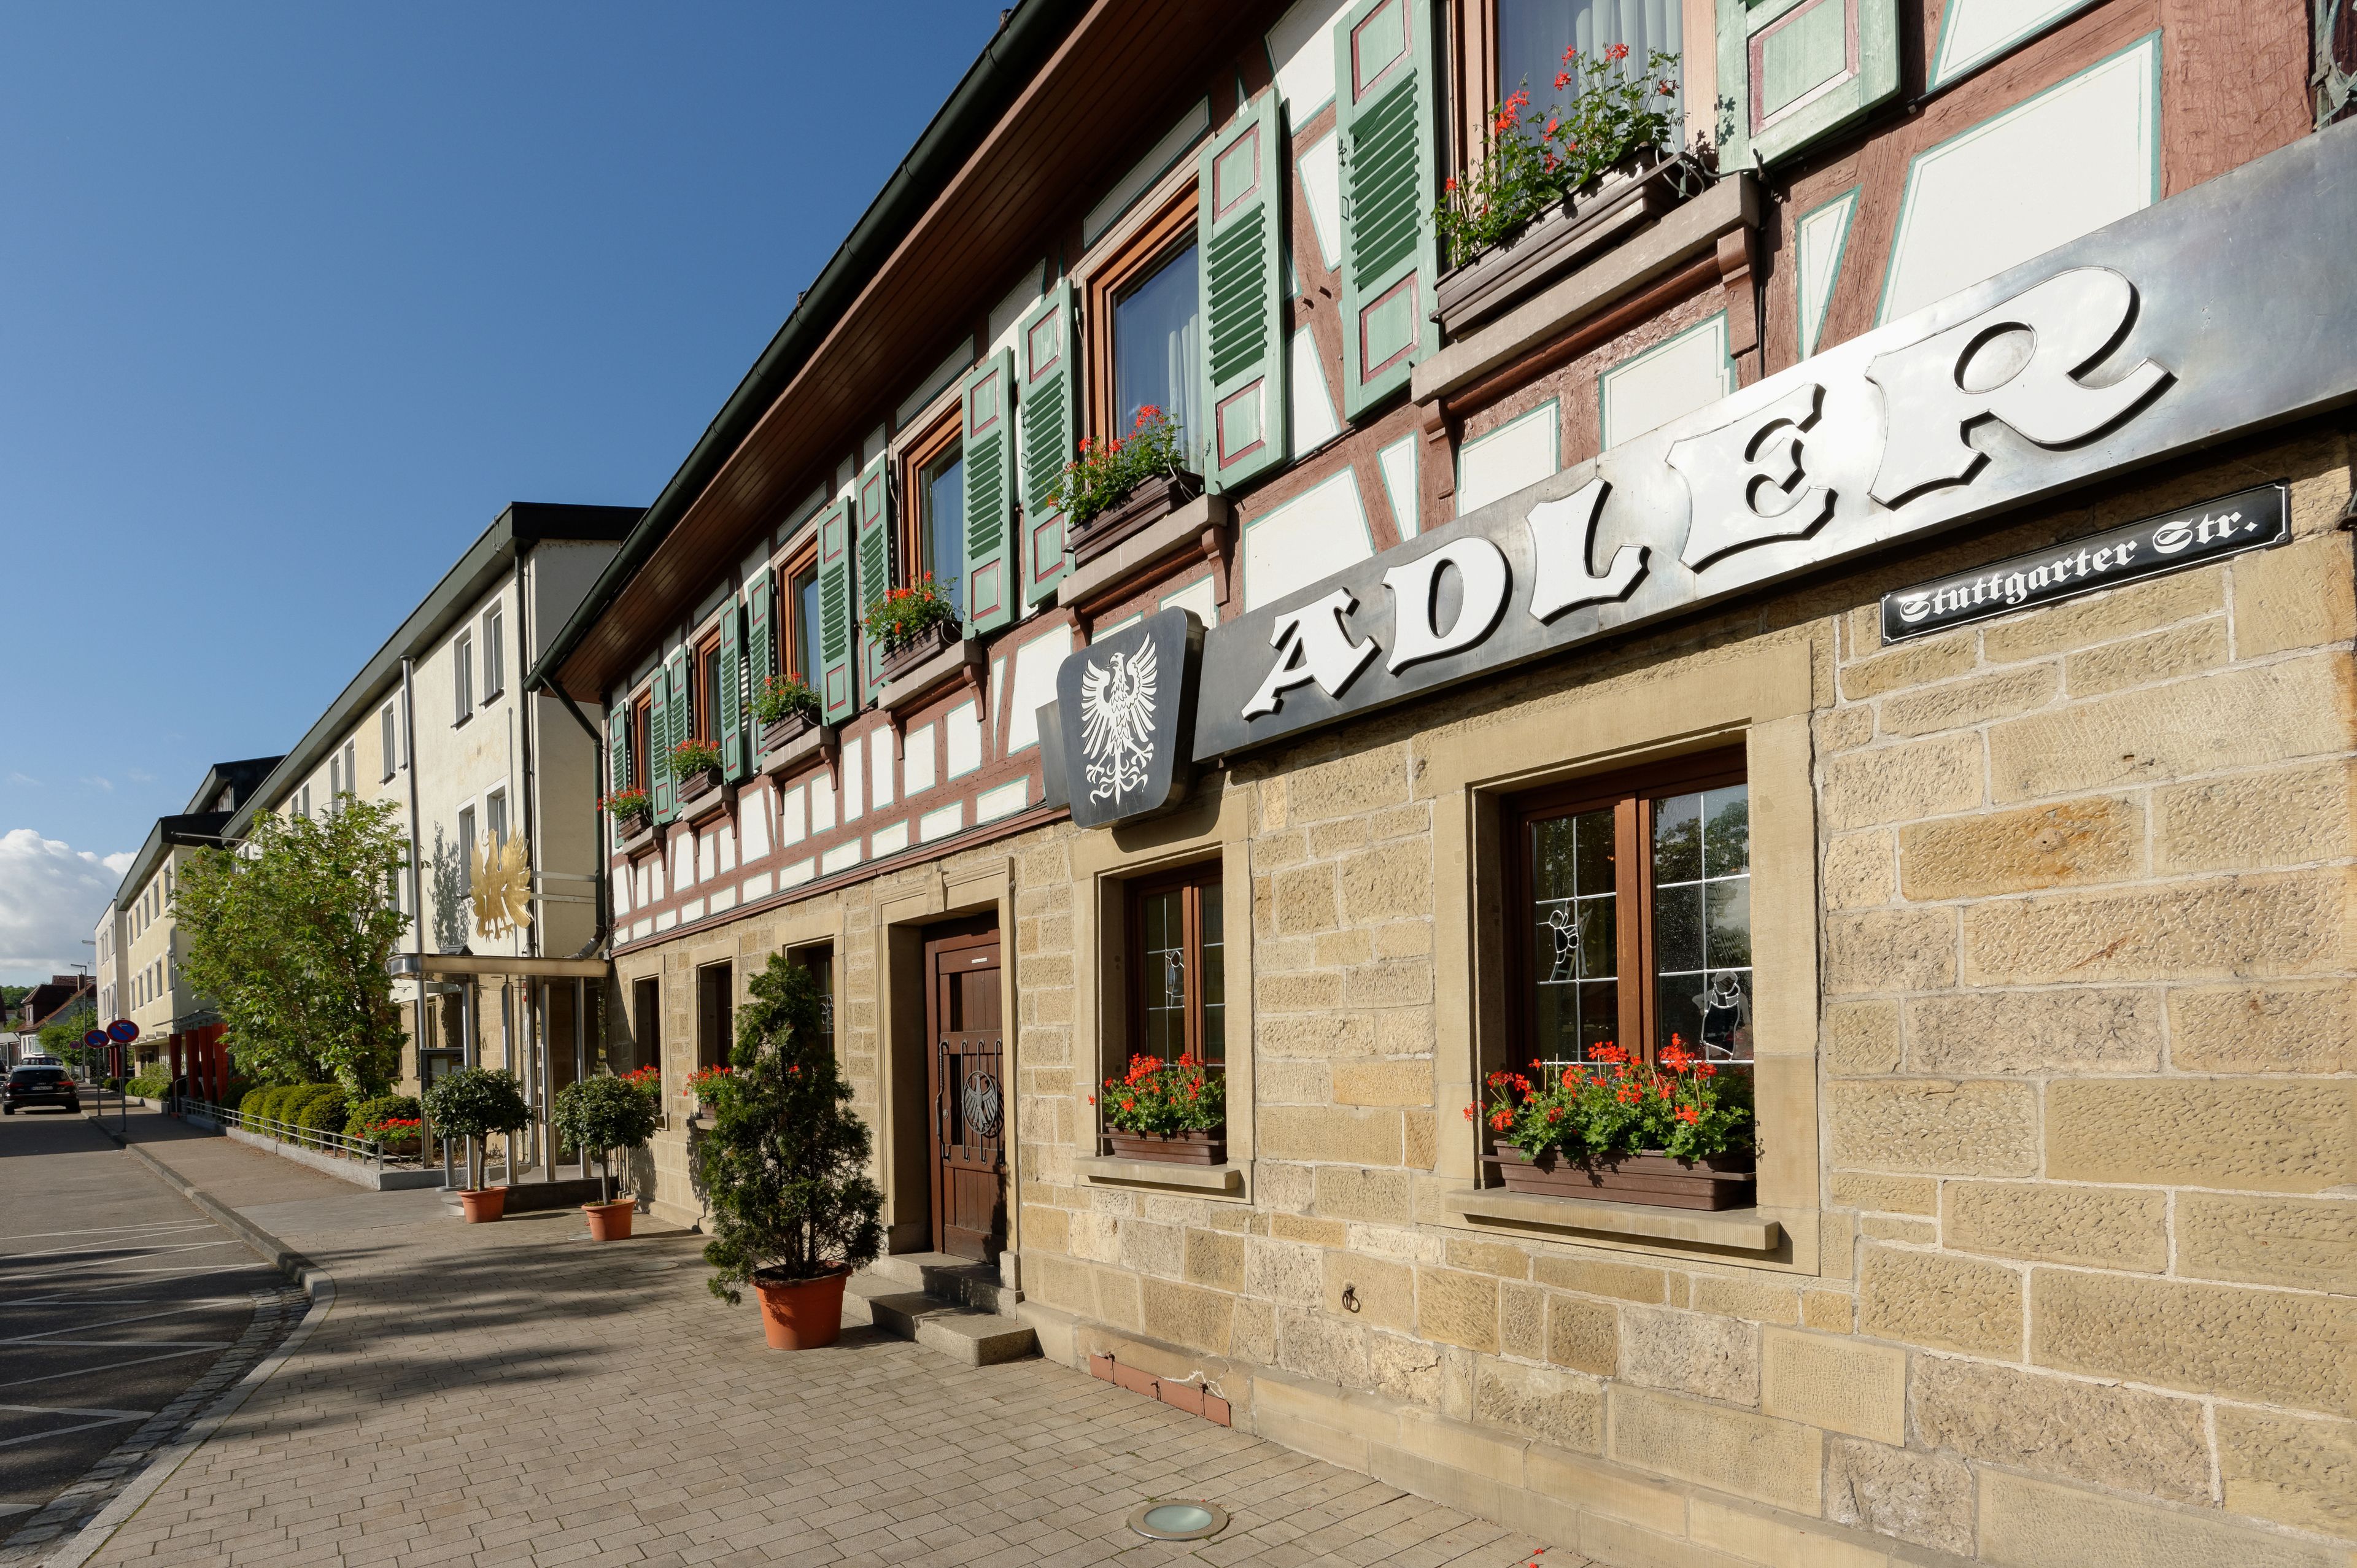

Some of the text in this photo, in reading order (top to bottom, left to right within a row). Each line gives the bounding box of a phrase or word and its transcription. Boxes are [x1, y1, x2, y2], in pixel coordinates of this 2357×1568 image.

[1241, 266, 2173, 720] ADLER
[1900, 509, 2259, 623] Stuttgarter Str.
